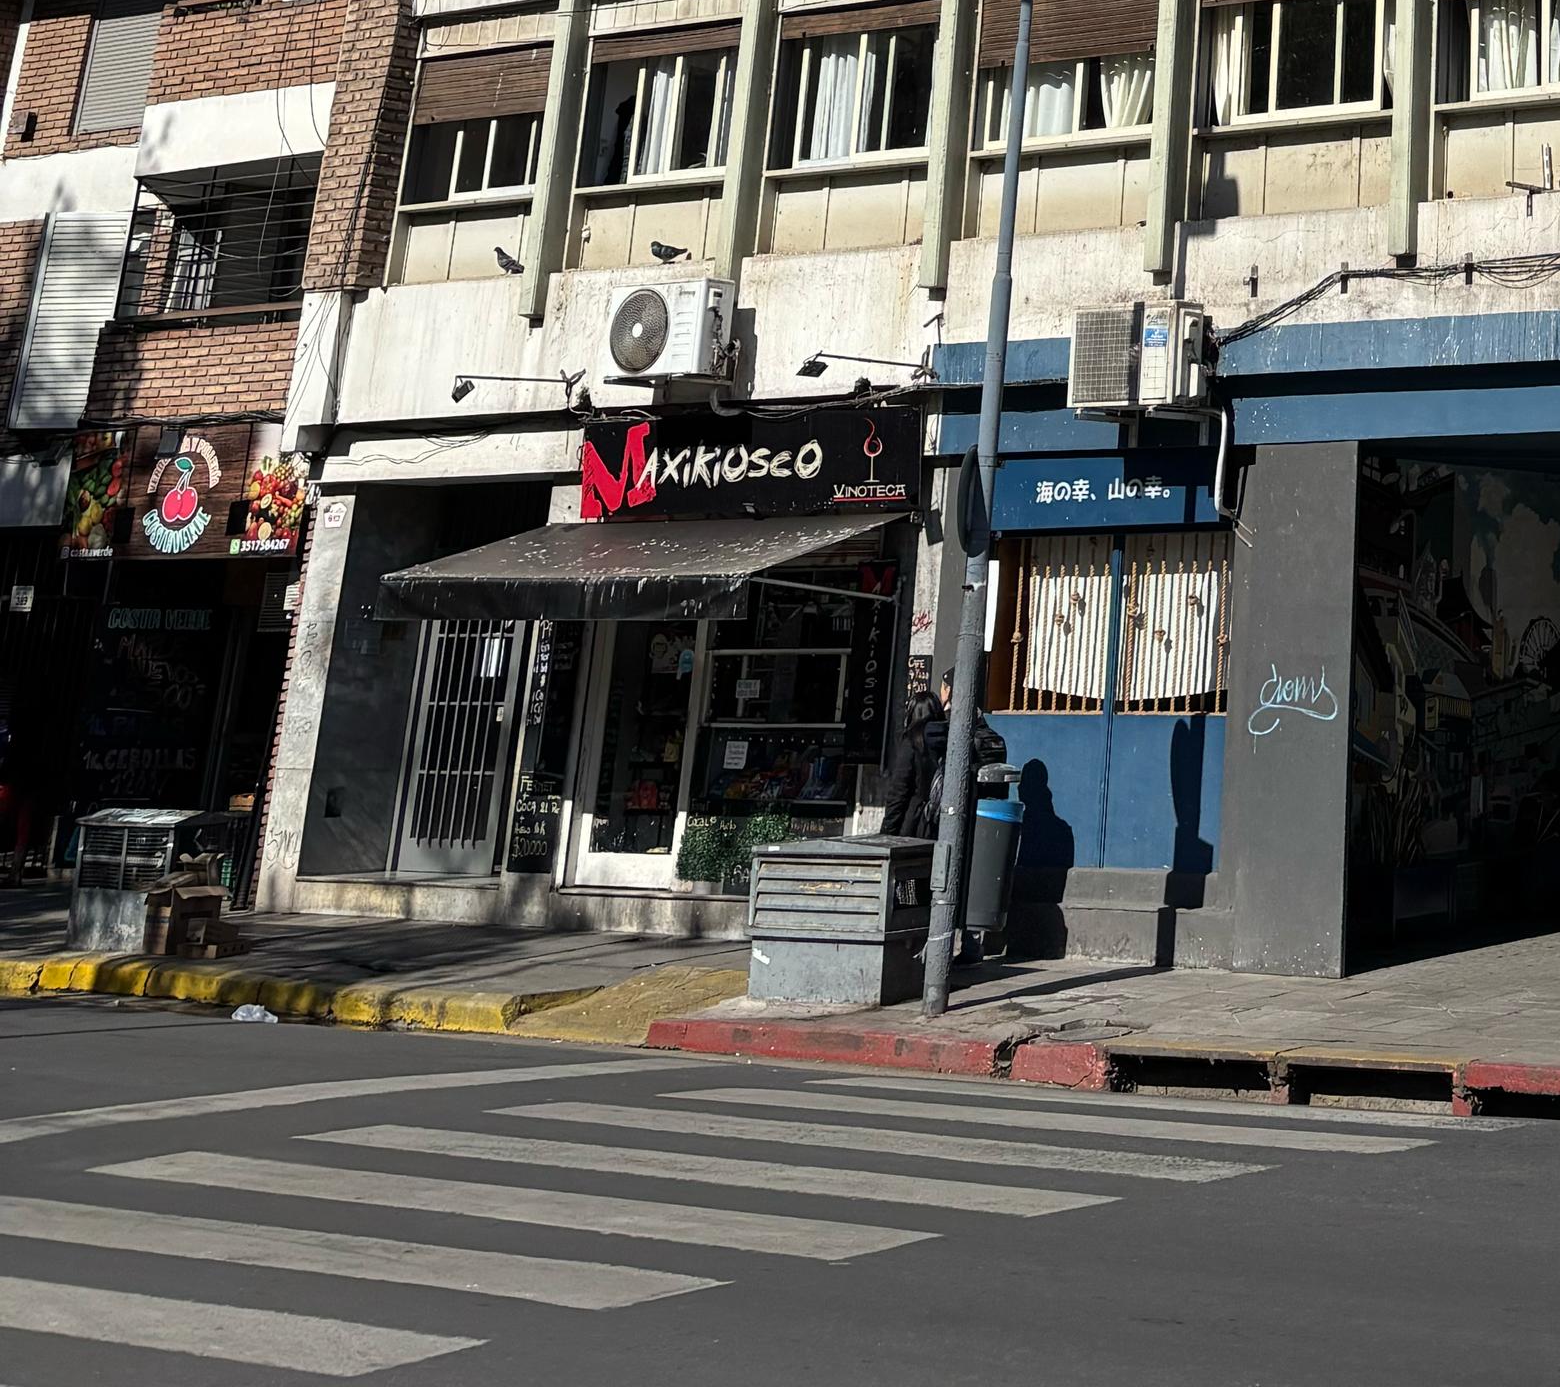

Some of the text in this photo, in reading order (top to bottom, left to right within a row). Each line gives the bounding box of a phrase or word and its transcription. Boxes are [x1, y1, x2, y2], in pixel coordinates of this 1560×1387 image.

[833, 483, 906, 498] VINOTECA
[1036, 476, 1171, 504] 海の幸、山の幸。
